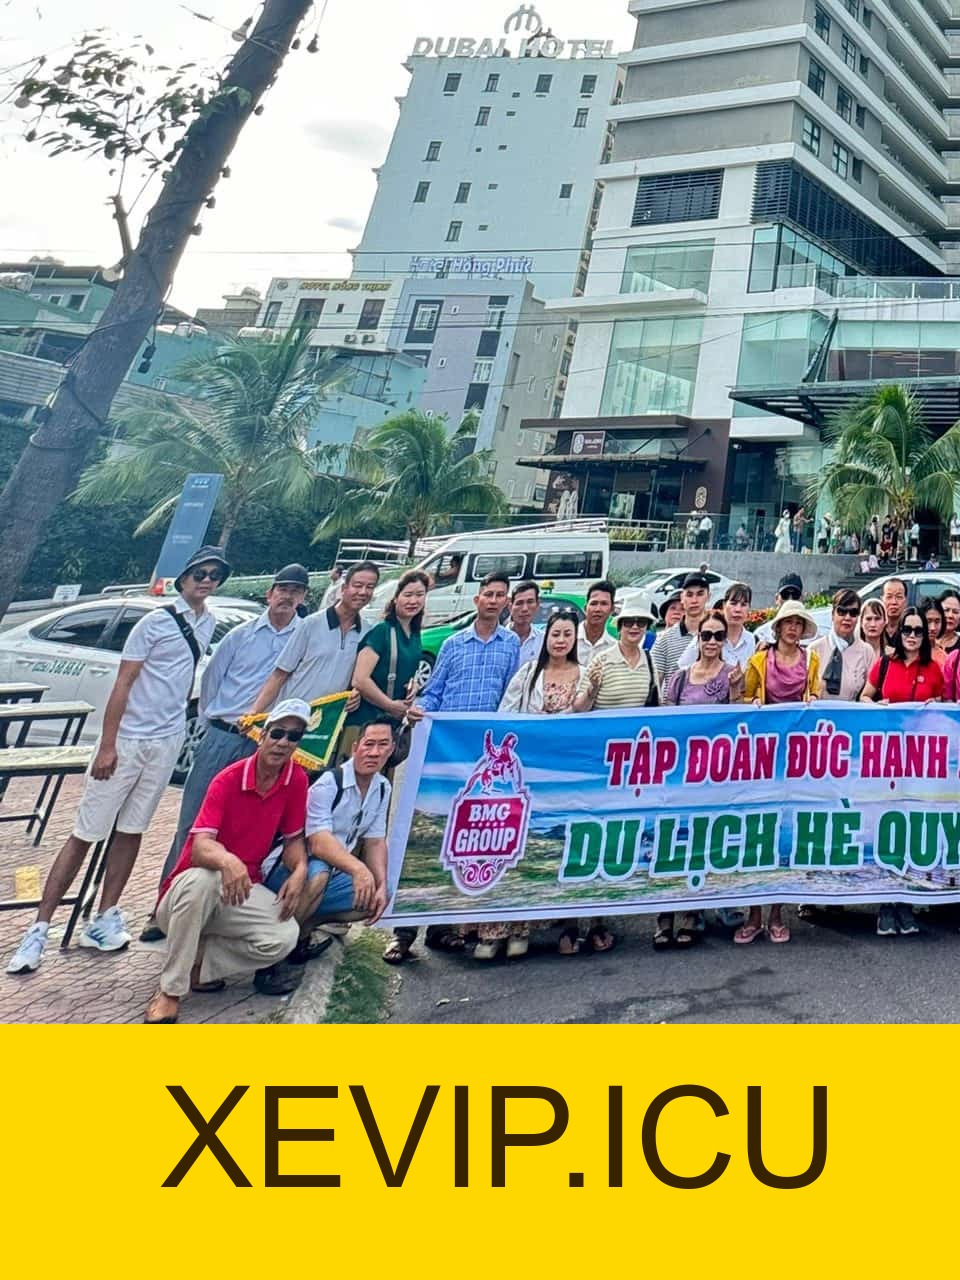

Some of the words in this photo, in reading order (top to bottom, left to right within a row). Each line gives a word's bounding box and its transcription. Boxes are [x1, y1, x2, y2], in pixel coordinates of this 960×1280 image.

[411, 36, 507, 58] DUBAI
[518, 37, 620, 59] HOTEL
[607, 729, 677, 798] TẬP
[685, 725, 778, 783] ĐOÀN
[786, 722, 850, 779] ĐỨC
[860, 735, 949, 790] HẠNH
[468, 803, 512, 822] BMG
[455, 827, 517, 853] GROUP
[563, 819, 642, 878] DU
[653, 811, 778, 888] LỊCH
[794, 798, 862, 866] HÈ
